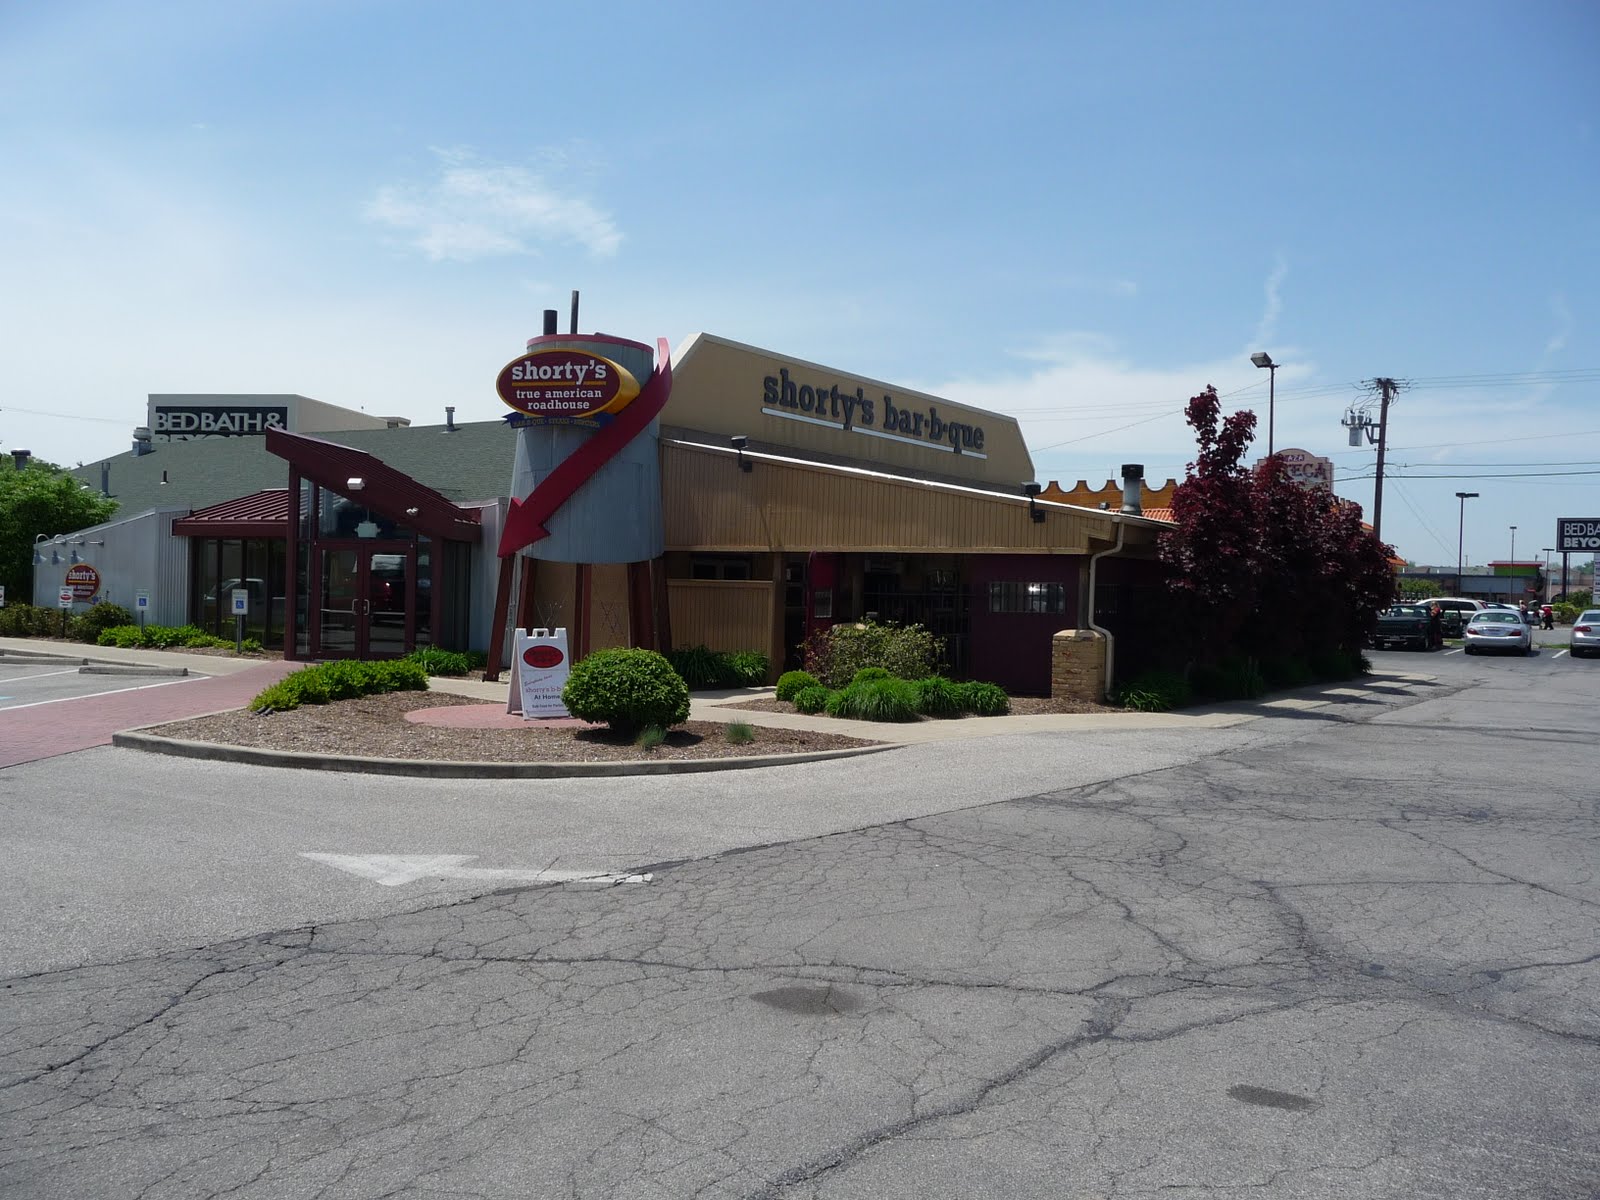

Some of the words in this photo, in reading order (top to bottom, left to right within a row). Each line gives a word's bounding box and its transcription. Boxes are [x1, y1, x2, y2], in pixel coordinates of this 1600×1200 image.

[512, 360, 607, 385] shorty's
[516, 389, 541, 399] true
[545, 388, 602, 399] american
[763, 368, 874, 430] shorty's
[527, 399, 590, 410] roadhouse
[155, 412, 200, 431] BED
[201, 412, 262, 431] BATH
[1564, 523, 1587, 536] BED
[68, 569, 96, 581] shorty's
